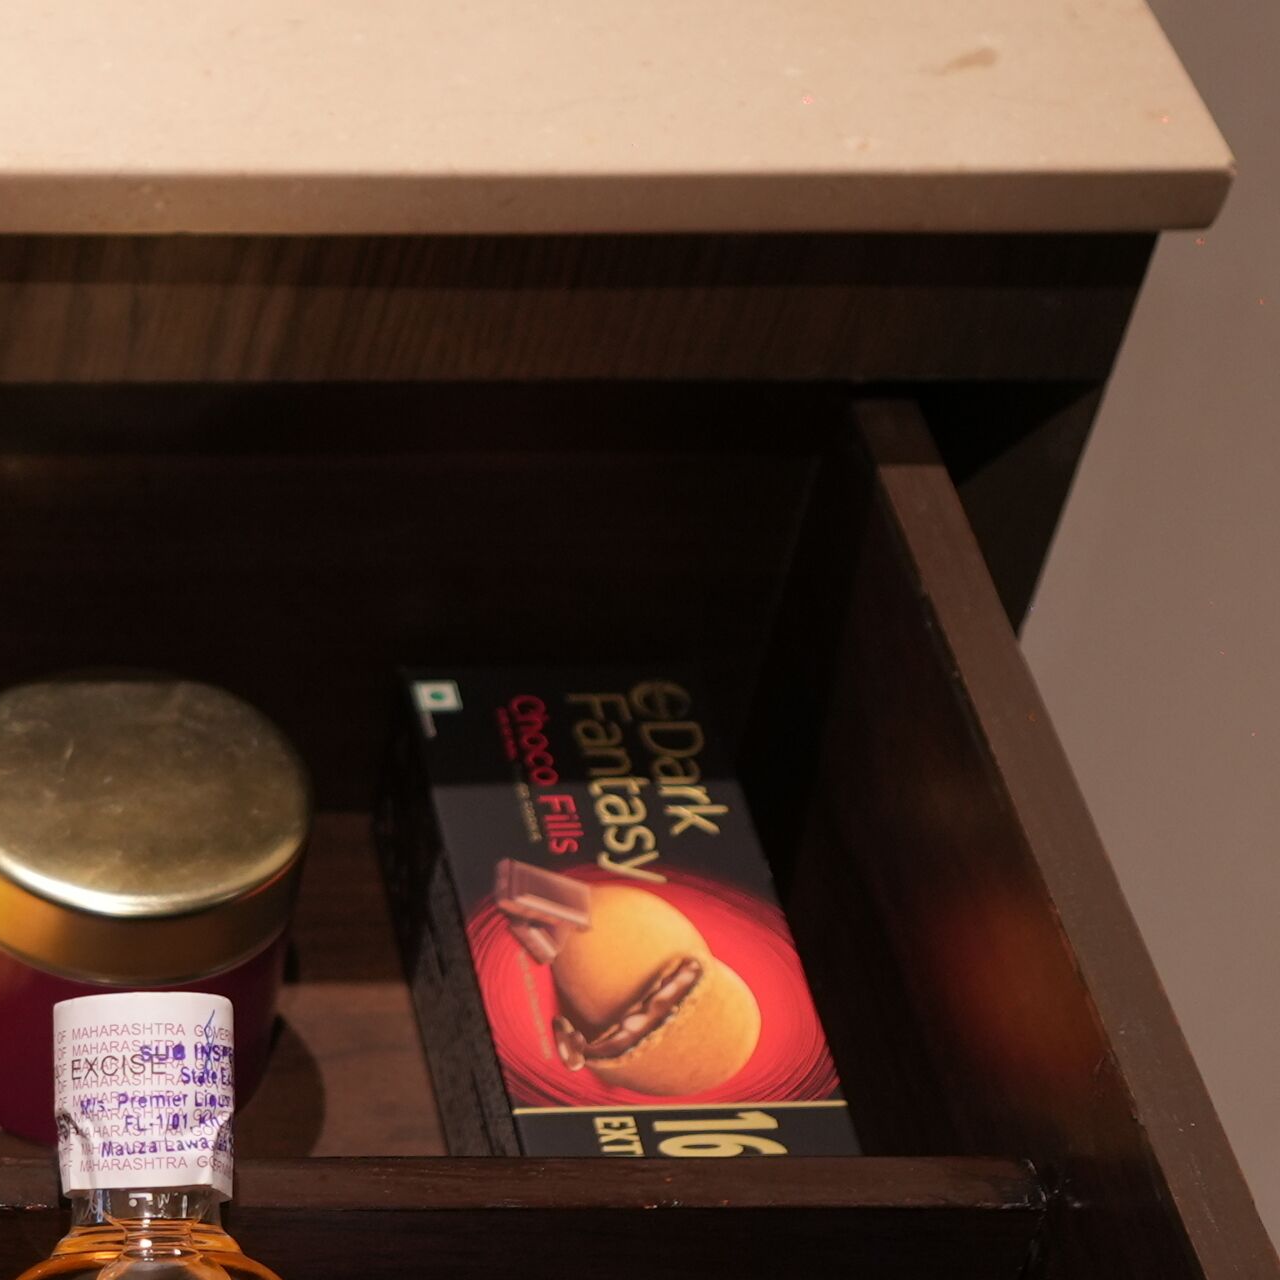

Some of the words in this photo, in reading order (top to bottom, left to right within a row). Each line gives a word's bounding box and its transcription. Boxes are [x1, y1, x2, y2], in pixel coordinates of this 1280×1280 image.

[565, 692, 668, 884] Fantasy
[640, 721, 729, 836] Dark
[537, 794, 585, 855] Fills
[71, 1022, 186, 1040] MAHARASHTRA
[71, 1055, 167, 1081] EXCISE
[118, 1091, 188, 1107] Premier
[101, 1142, 158, 1158] Mauza
[652, 1110, 789, 1157] 16
